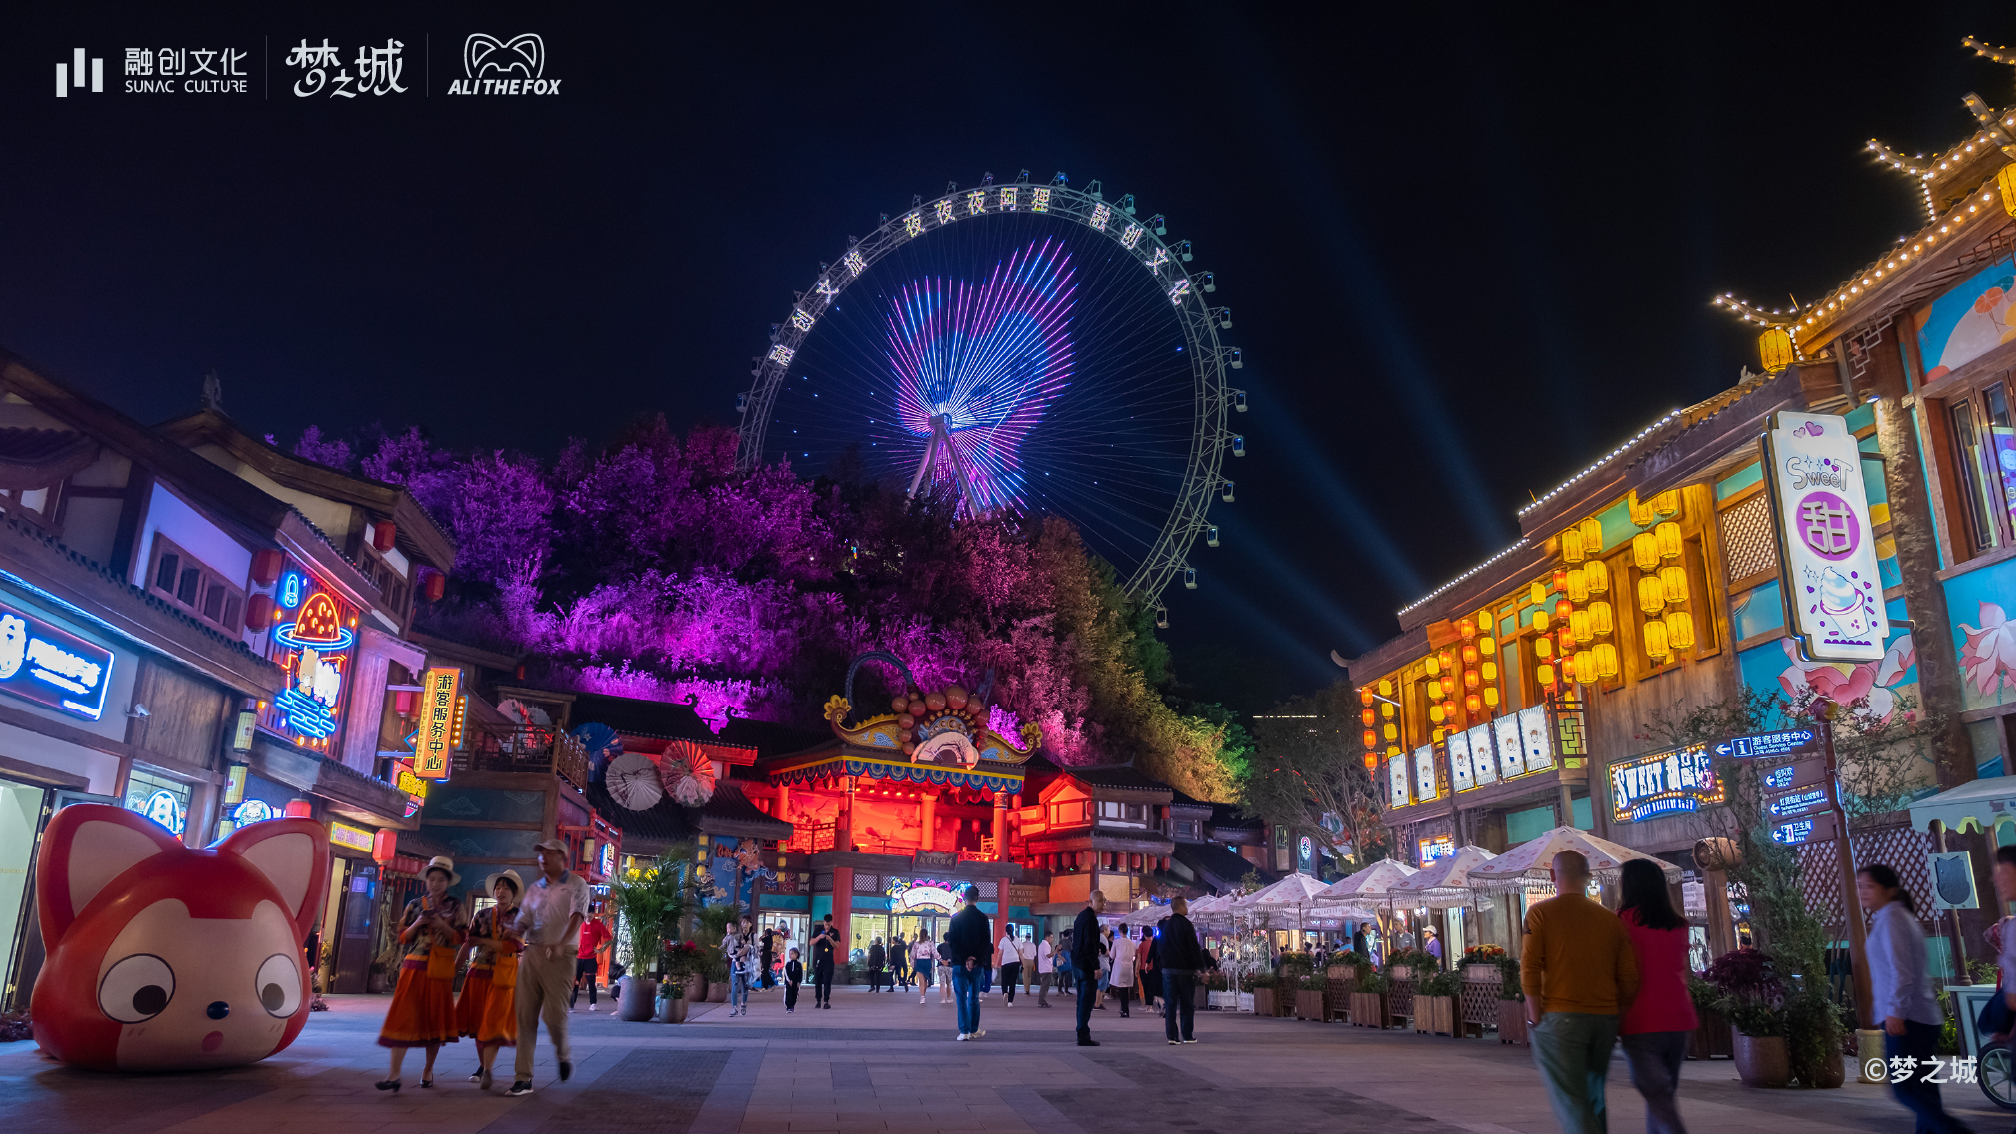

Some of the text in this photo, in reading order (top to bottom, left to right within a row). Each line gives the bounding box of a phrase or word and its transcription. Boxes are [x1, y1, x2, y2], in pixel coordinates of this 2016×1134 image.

[1089, 202, 1190, 305] 融创文化
[1802, 501, 1851, 555] 甜
[425, 674, 454, 771] 游客服务中心
[1752, 730, 1812, 746] 游客服务中心
[1793, 820, 1811, 832] 卫生间
